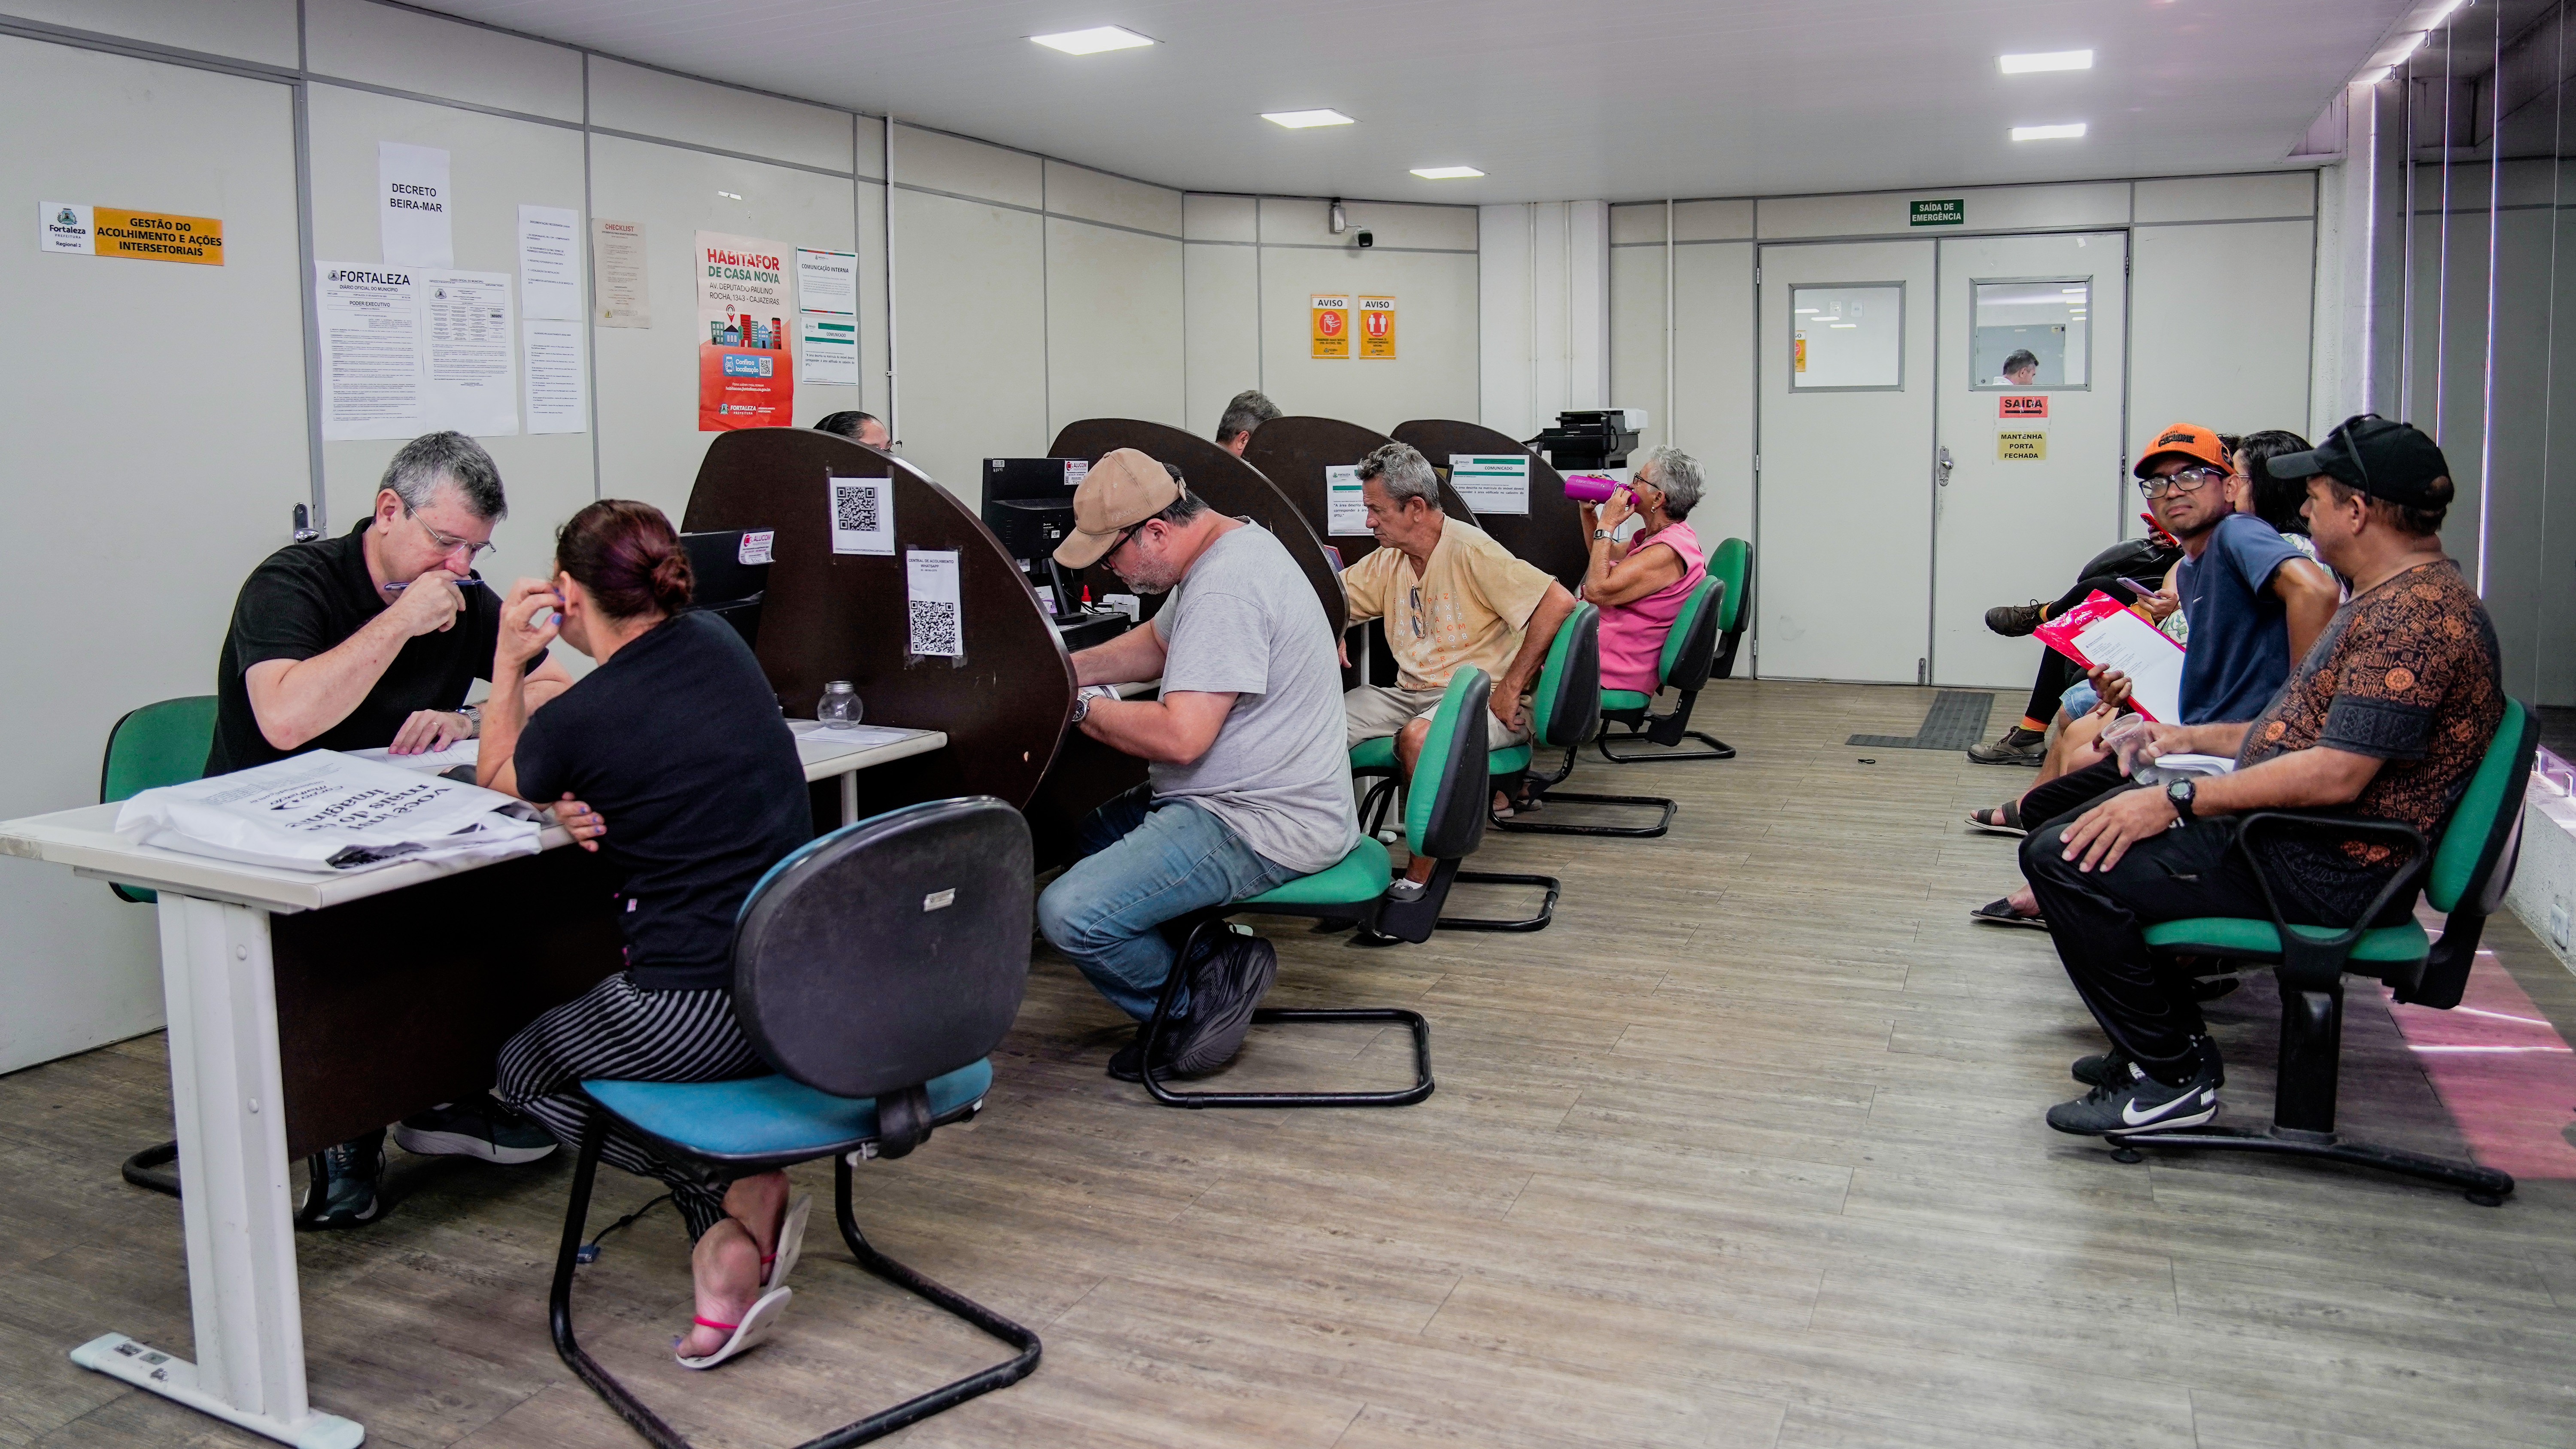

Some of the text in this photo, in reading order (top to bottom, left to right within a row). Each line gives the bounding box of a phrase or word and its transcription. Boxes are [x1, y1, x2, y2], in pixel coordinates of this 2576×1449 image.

[392, 183, 436, 197] DECRETO
[390, 198, 442, 212] BEIRA-MAR
[1920, 203, 1941, 211] SAÍDA
[1912, 212, 1961, 222] EMERGÊNCIA
[49, 225, 85, 234] Fortaleza
[130, 218, 191, 231] GESTÃO DO
[97, 227, 222, 246] ACOLHIMENTO E AÇÕES
[119, 241, 203, 256] INTERSETORIAIS
[708, 249, 779, 270] HABITAFOR
[340, 270, 410, 285] FORTALEZA
[708, 266, 780, 284] DE CASA NOVA
[720, 283, 750, 292] DEPUTADO
[710, 292, 732, 301] ROCHA,
[750, 296, 780, 305] CAJAZEIRAS.
[736, 366, 759, 374] localização
[2005, 398, 2042, 408] SAÍDA
[340, 784, 430, 822] mais do
[392, 787, 453, 814] você
[2128, 1061, 2146, 1080] NIKE
